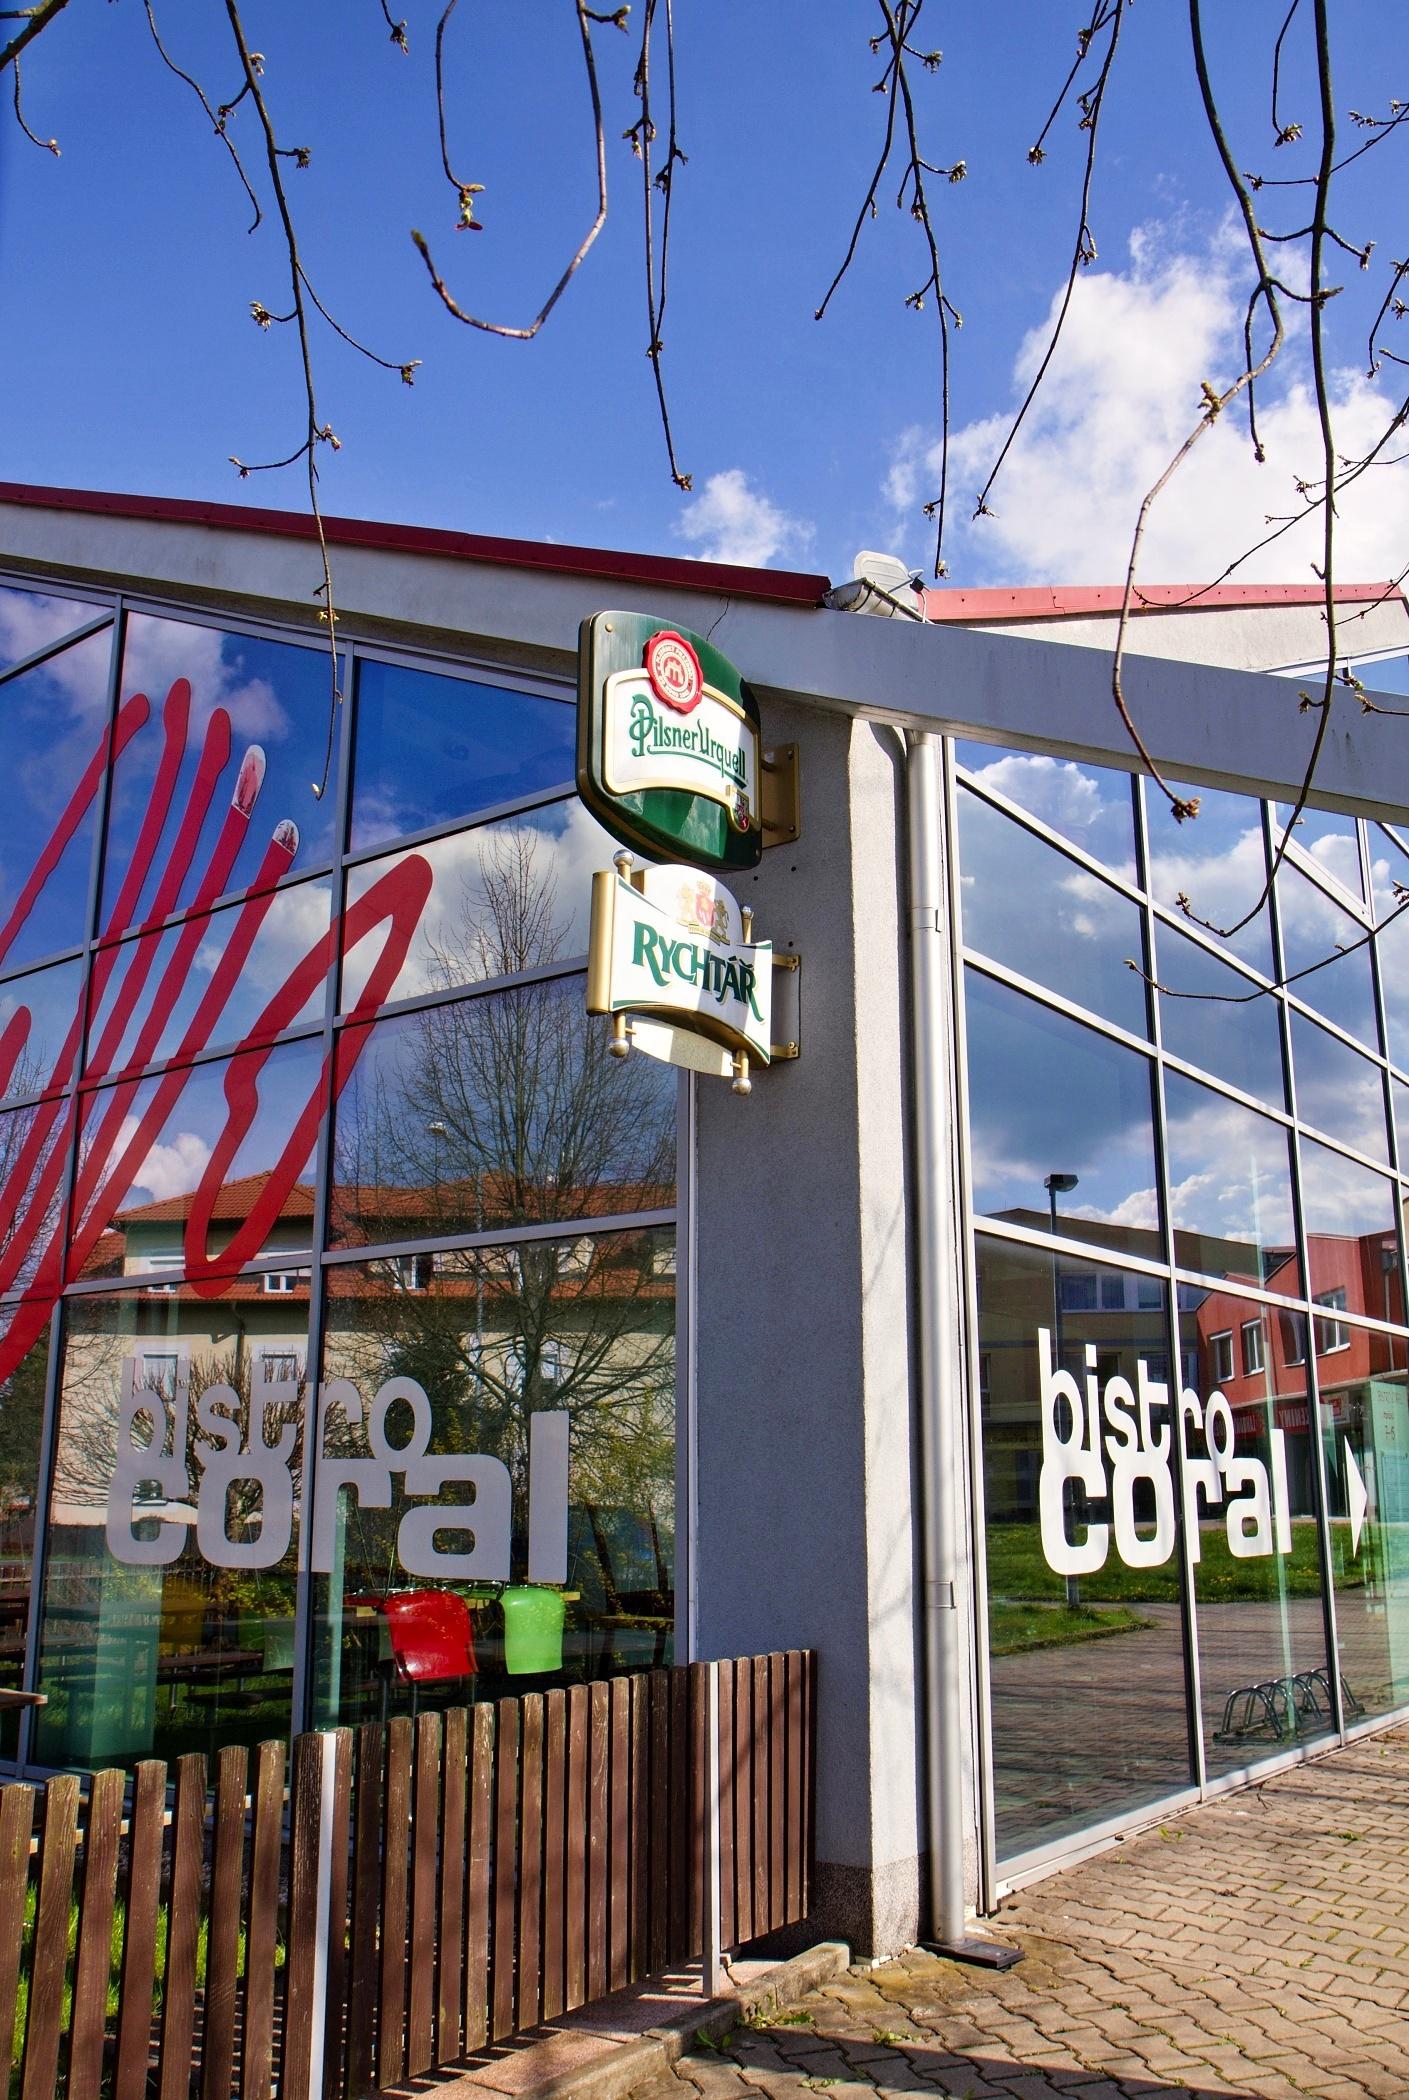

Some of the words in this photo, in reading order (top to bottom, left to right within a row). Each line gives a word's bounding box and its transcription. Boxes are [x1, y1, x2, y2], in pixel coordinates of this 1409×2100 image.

[629, 693, 699, 757] Pilsner
[697, 718, 746, 780] Urquell
[631, 920, 766, 1024] RYCHTÁŘ
[115, 1357, 432, 1472] bistro
[1038, 1328, 1235, 1473] bistro
[105, 1410, 570, 1584] coral
[1039, 1428, 1292, 1576] coral
